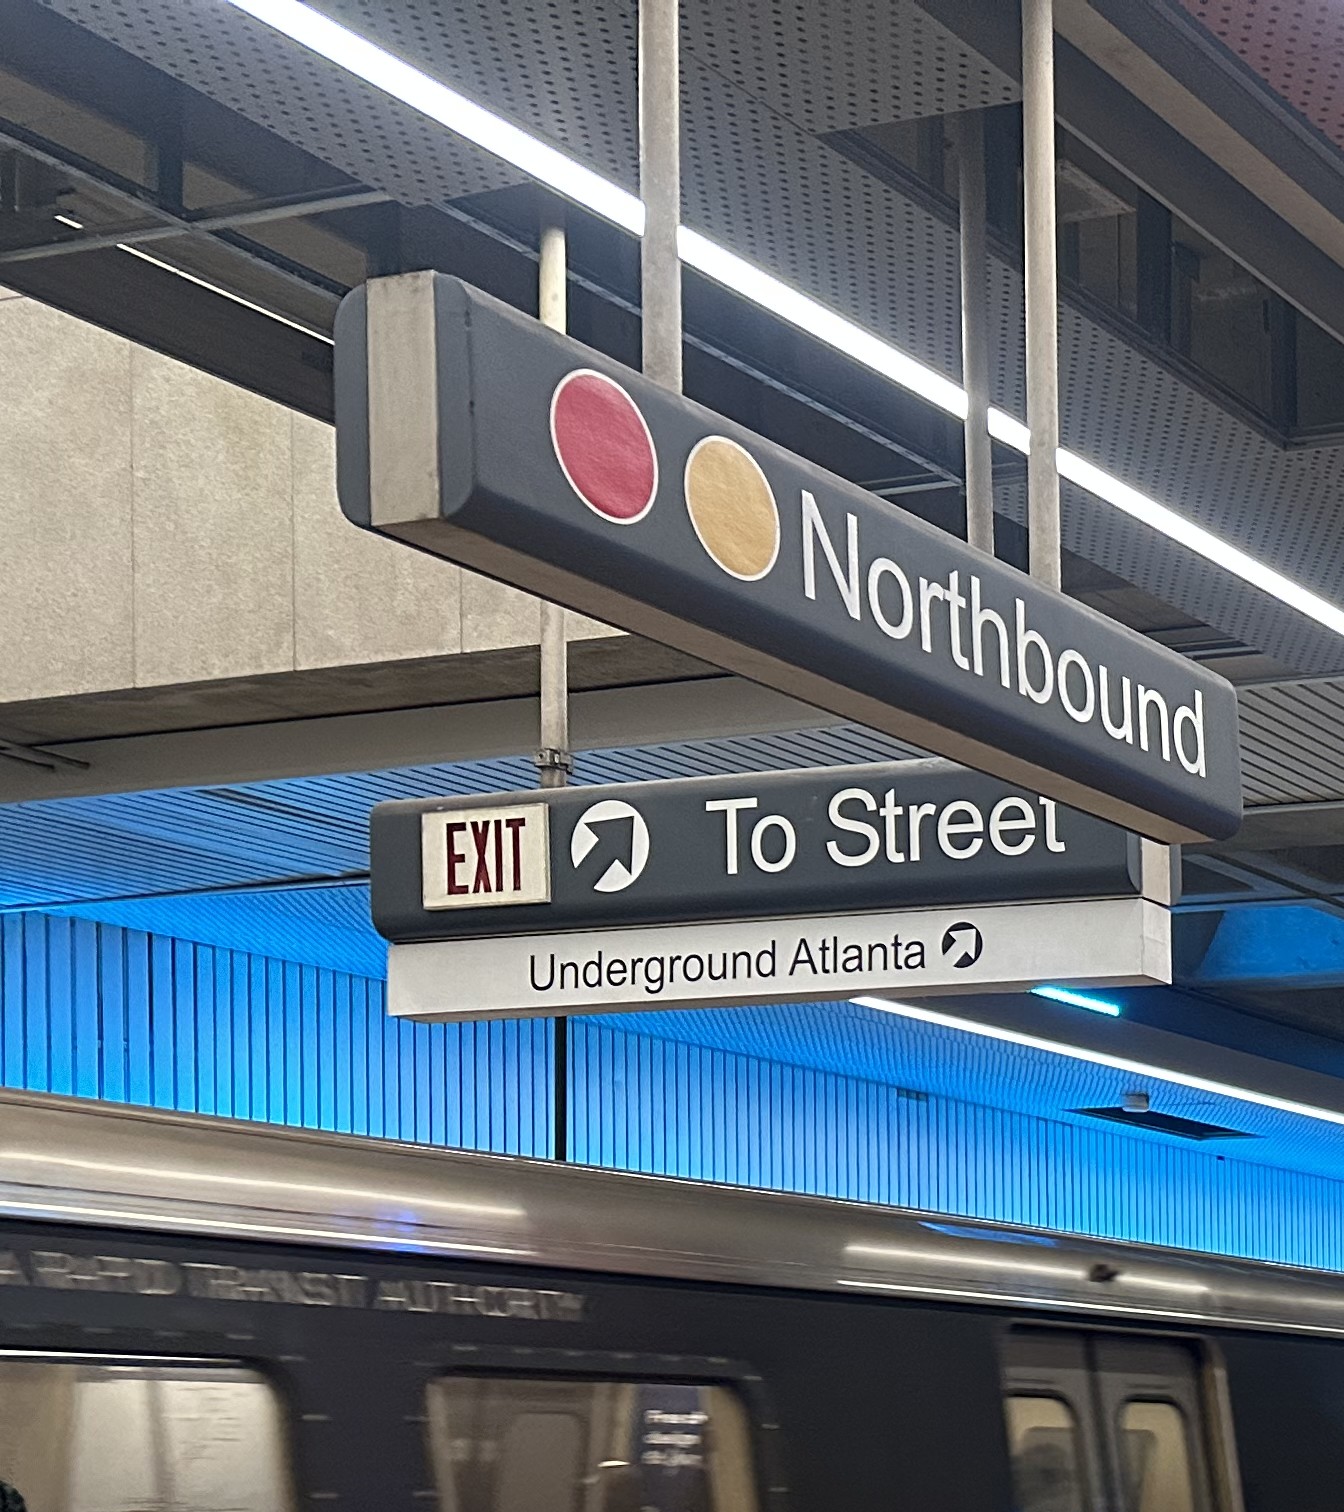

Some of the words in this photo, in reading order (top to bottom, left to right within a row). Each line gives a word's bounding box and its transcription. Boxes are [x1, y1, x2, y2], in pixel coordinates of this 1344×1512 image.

[800, 490, 1207, 777] Northbound
[447, 818, 526, 896] EXIT
[706, 797, 797, 875] To
[826, 787, 1066, 868] Street
[529, 939, 777, 995] Underground
[789, 934, 926, 977] Atlanta
